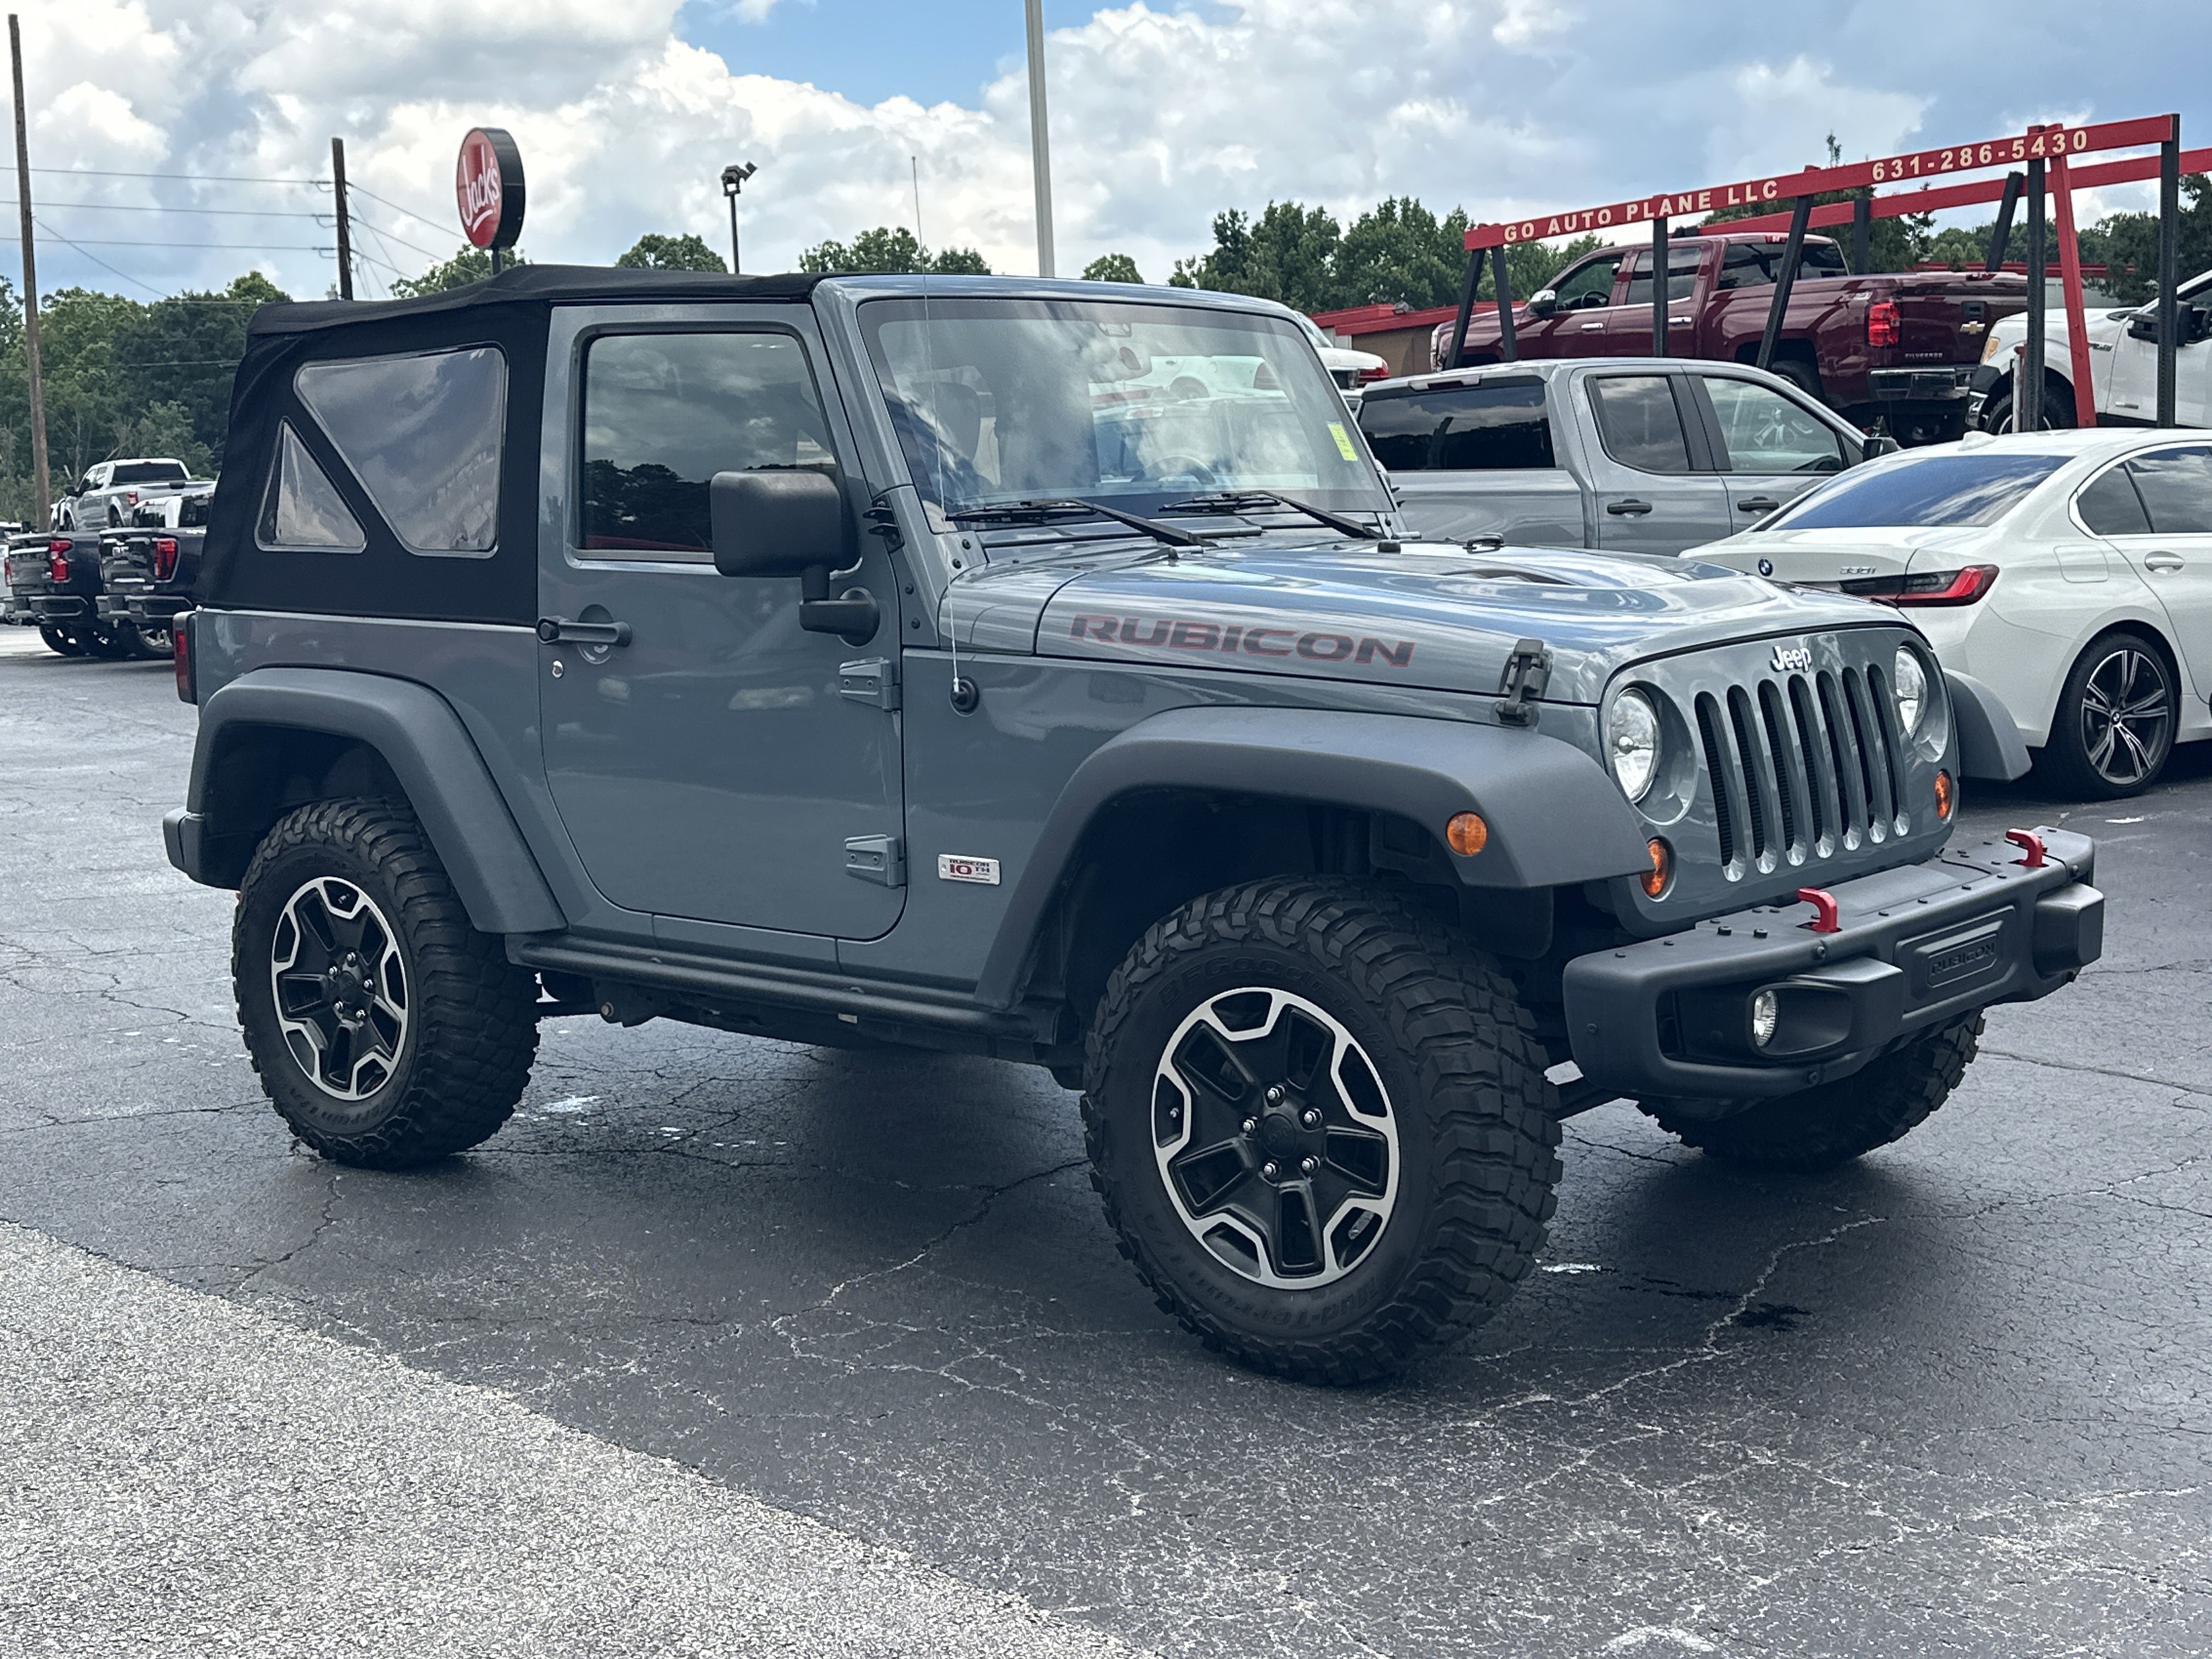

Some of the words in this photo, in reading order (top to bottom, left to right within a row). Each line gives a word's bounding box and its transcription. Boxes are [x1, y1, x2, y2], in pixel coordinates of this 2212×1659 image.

[1872, 130, 2087, 182] 631-286-5430
[1504, 222, 1534, 242] GO
[1548, 208, 1612, 235] AUTO
[1627, 191, 1711, 221] PLANE
[1728, 179, 1778, 205] LLC
[1069, 613, 1415, 668] RUBICON
[1770, 645, 1812, 672] Jeep
[1931, 943, 1995, 977] RUBICON
